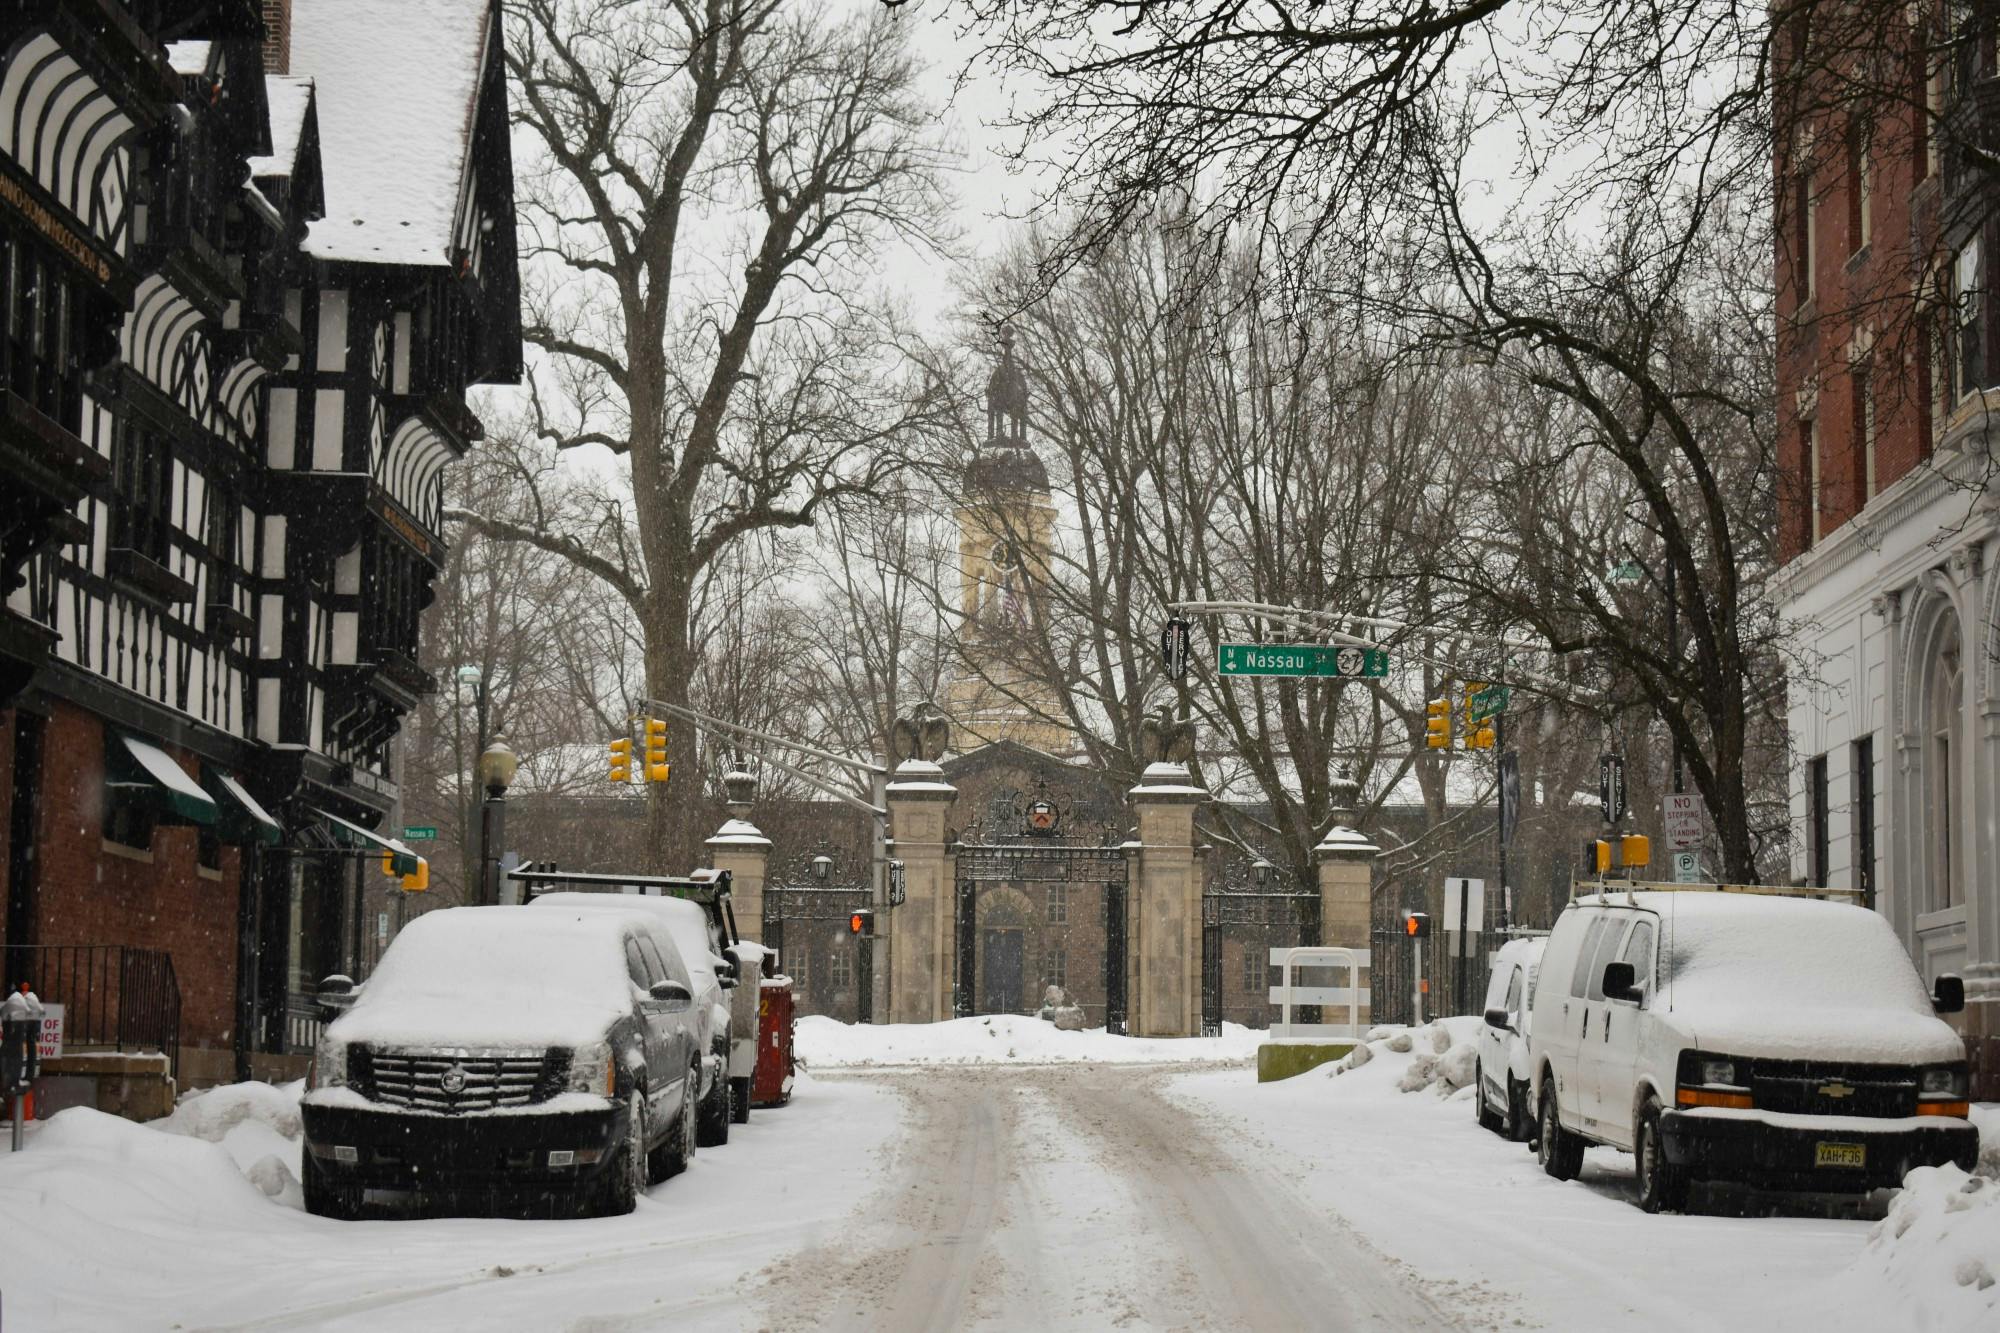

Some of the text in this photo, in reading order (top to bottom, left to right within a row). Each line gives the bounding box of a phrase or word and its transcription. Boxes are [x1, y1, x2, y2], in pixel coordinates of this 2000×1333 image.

[1227, 648, 1234, 658] N
[1246, 652, 1304, 668] Nassau
[1341, 653, 1359, 670] 27
[1674, 798, 1691, 808] NO
[760, 999, 769, 1016] 2
[44, 1019, 60, 1030] OF
